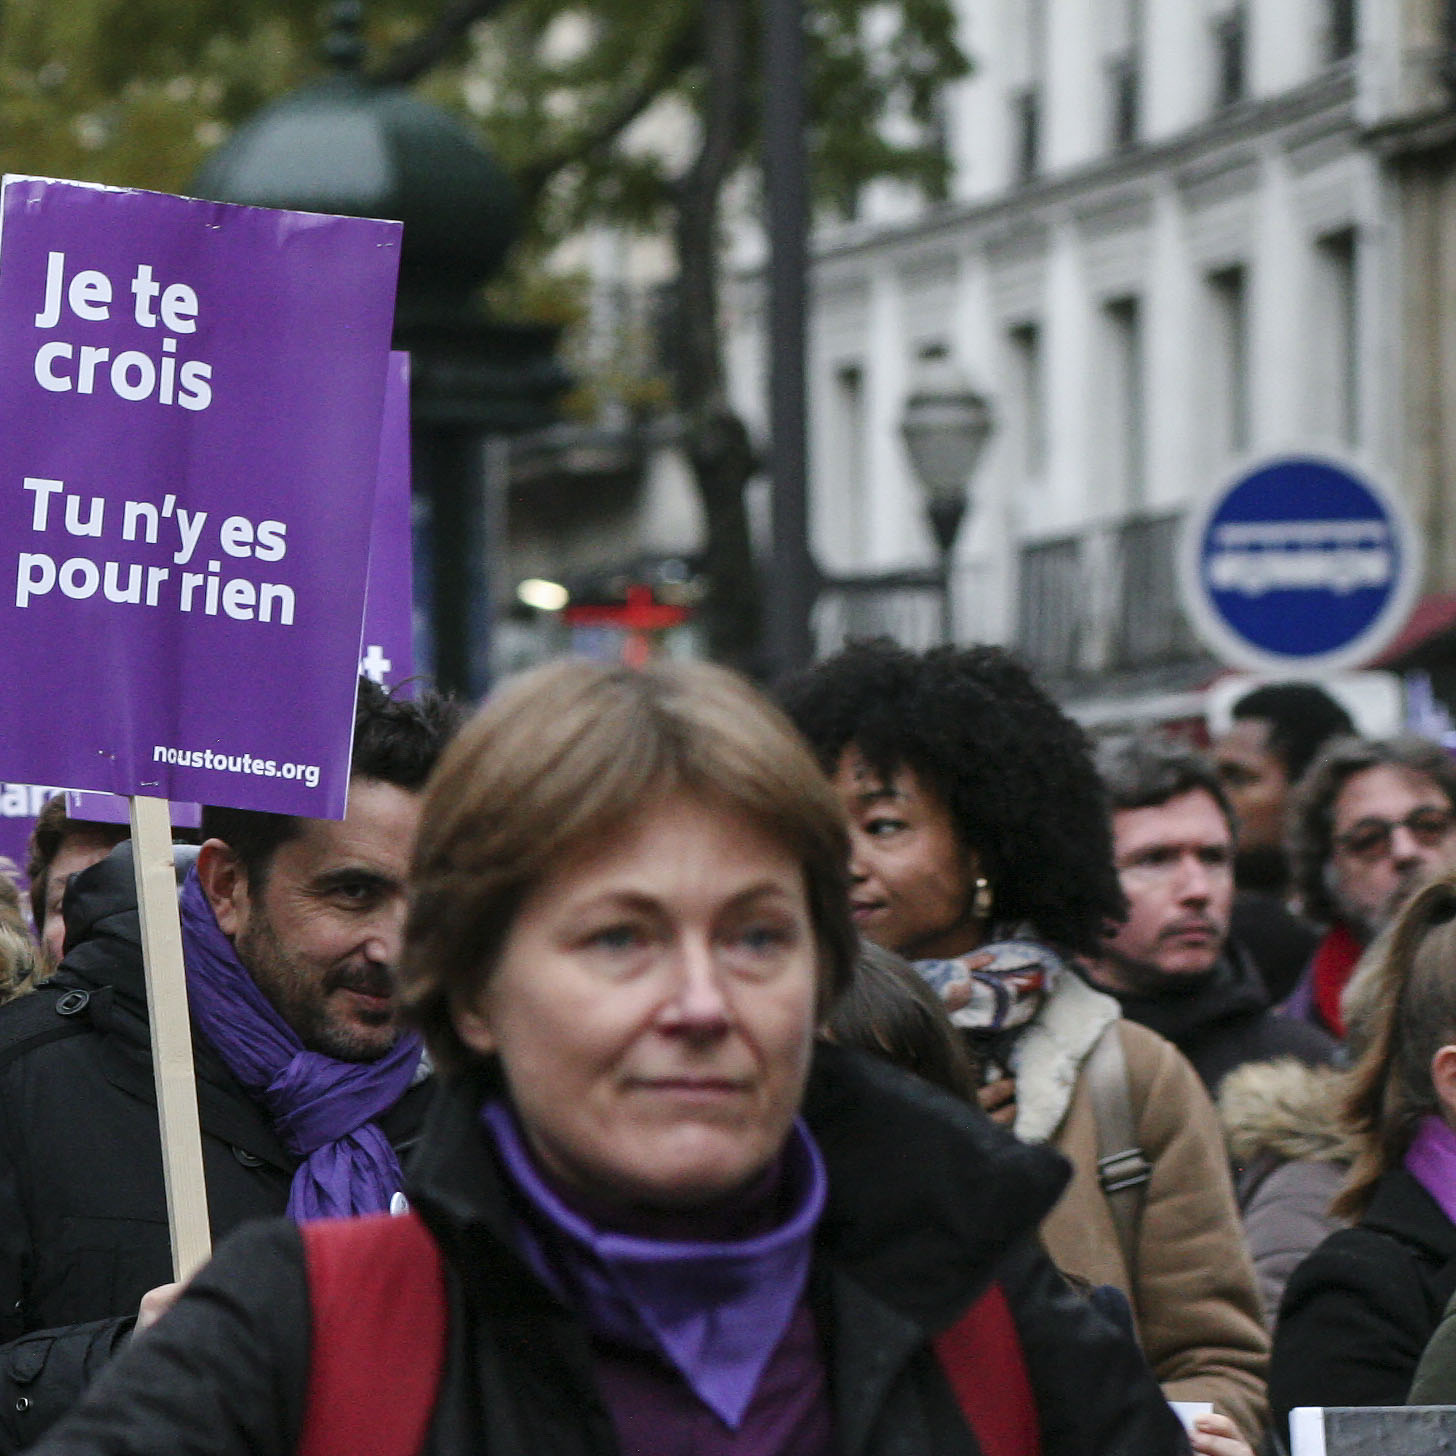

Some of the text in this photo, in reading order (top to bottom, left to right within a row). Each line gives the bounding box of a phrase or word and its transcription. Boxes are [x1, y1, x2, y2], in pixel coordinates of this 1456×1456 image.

[34, 251, 199, 334] Je te
[33, 338, 212, 411] crois
[23, 477, 105, 537] Tu
[219, 515, 288, 562] es
[15, 552, 170, 608] pour
[180, 559, 296, 626] rien
[152, 744, 321, 787] noustoutes.org
